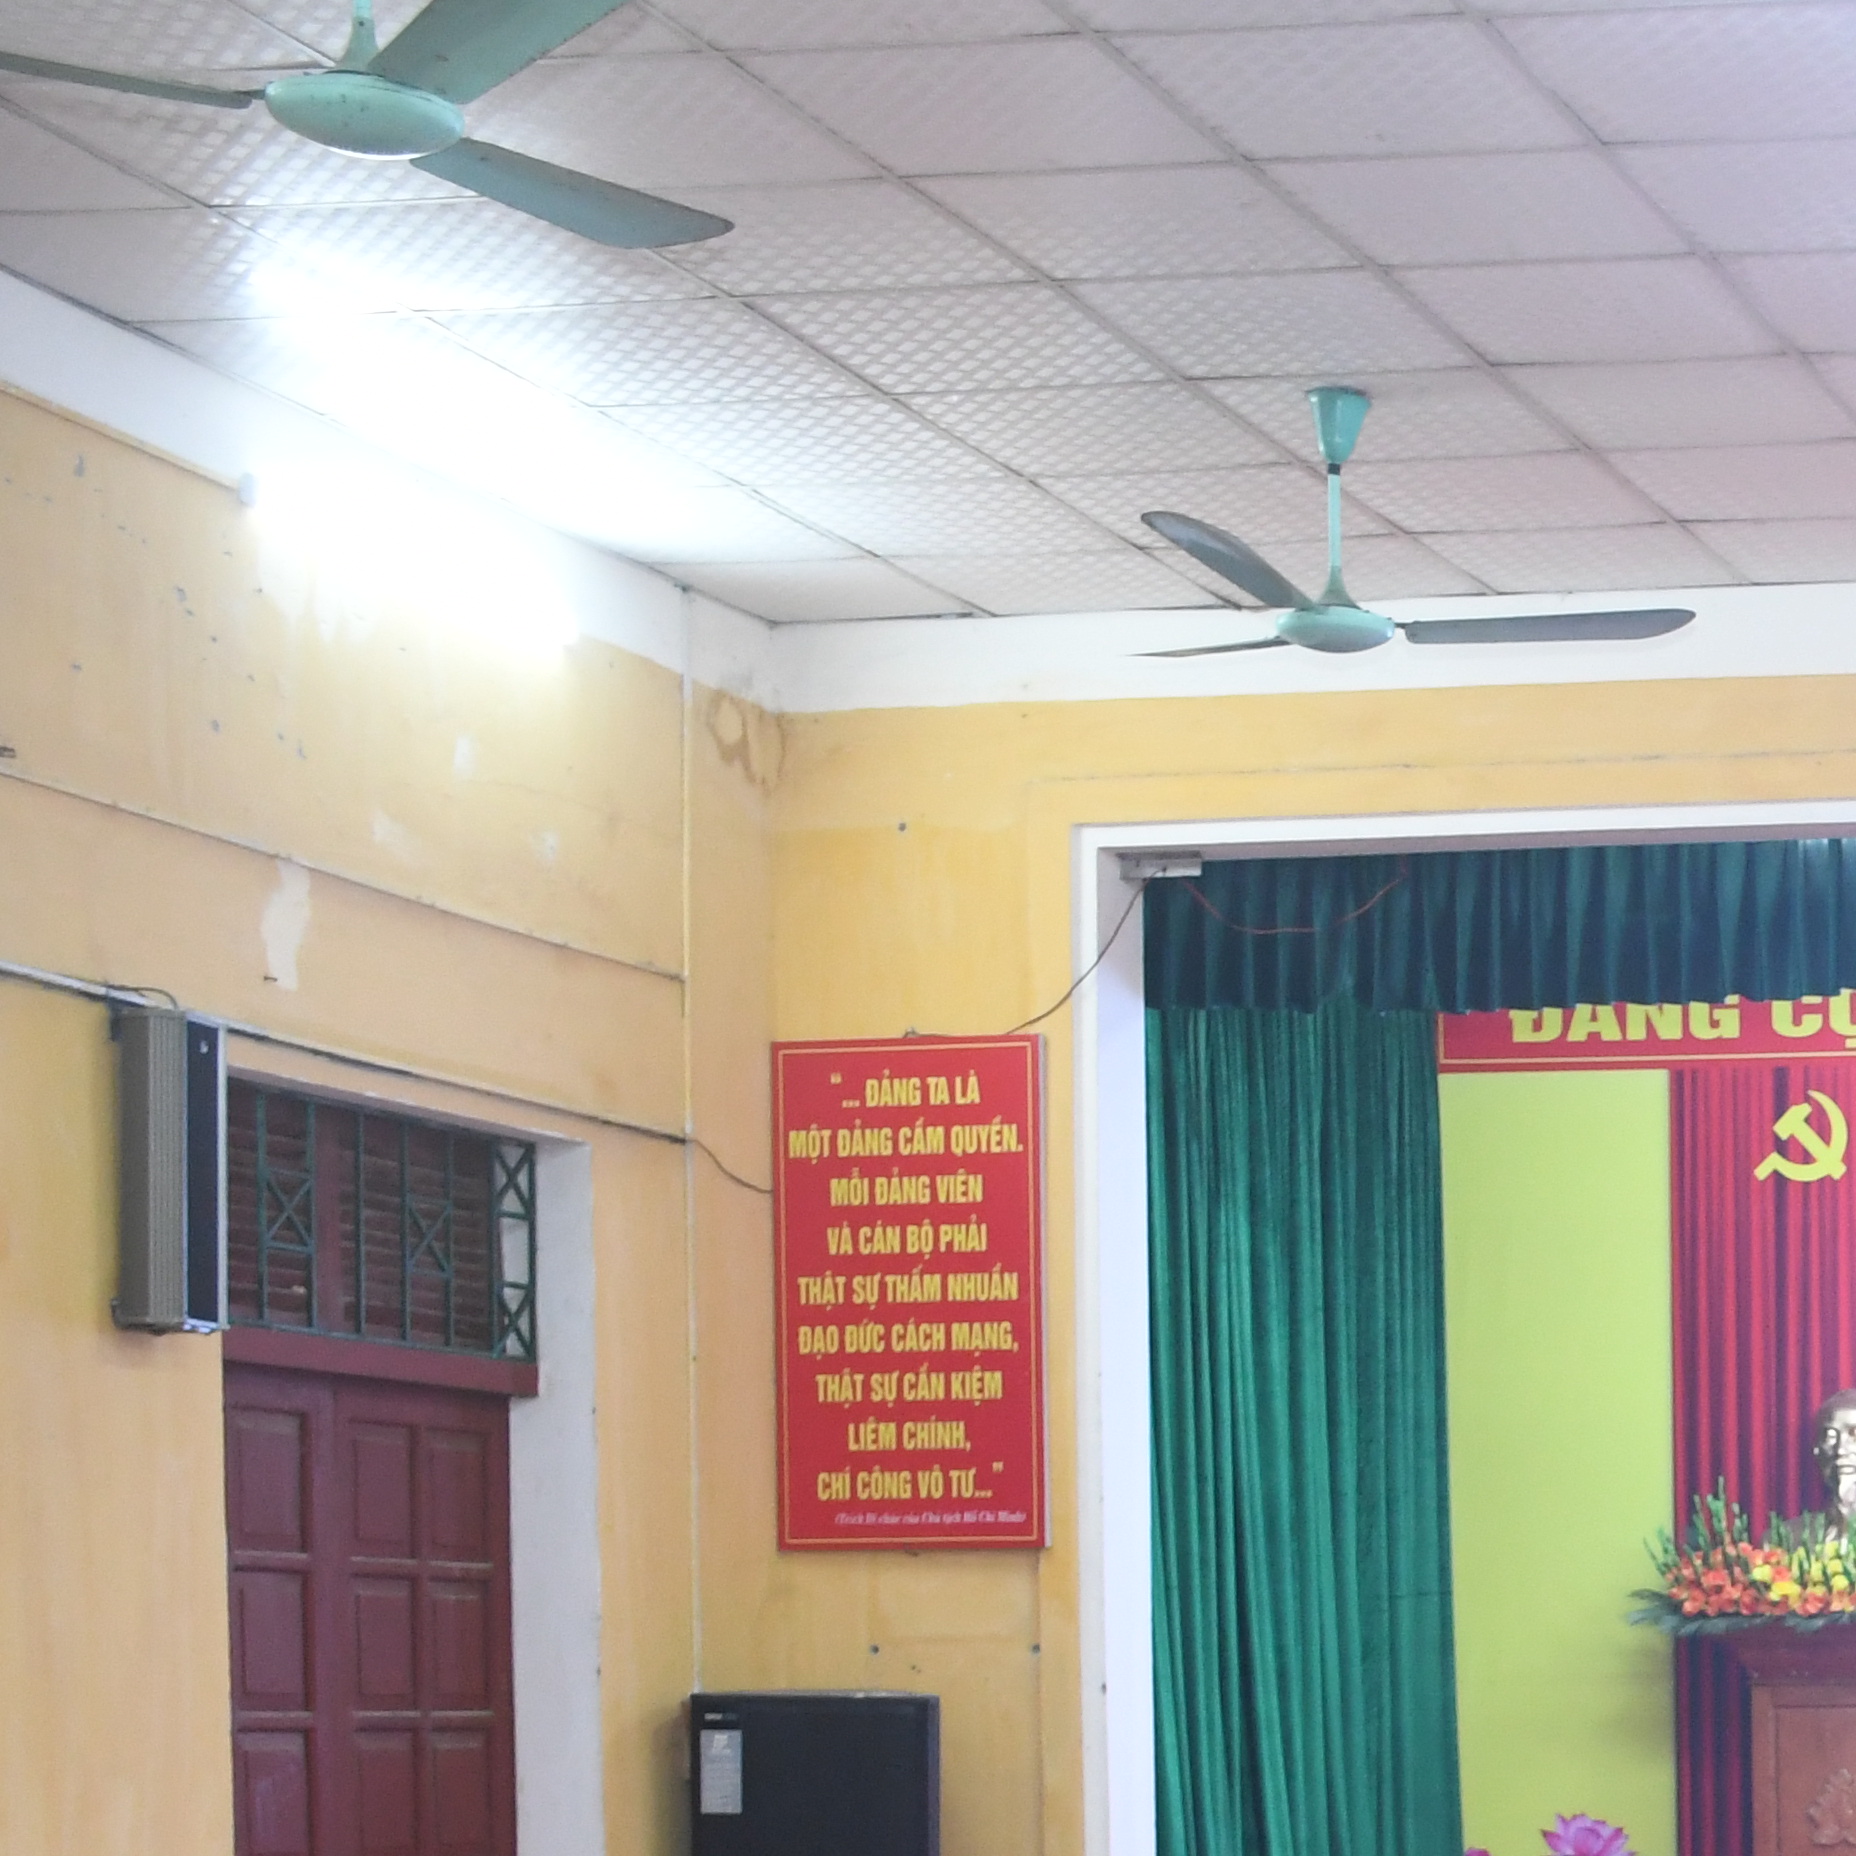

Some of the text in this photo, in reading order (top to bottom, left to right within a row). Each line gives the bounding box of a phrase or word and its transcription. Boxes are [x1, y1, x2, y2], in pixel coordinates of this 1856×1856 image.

[865, 1069, 921, 1107] ĐẢNG
[926, 1076, 950, 1105] TA
[955, 1070, 980, 1105] LÀ
[788, 1124, 832, 1164] MỘT
[837, 1119, 893, 1157] ĐẢNG
[874, 1168, 931, 1205] ĐẢNG
[936, 1170, 983, 1203] VIÊN
[827, 1214, 987, 1259] VÀ CÁN BỘ PHẢI
[798, 1271, 846, 1310] THẬT
[853, 1273, 881, 1309] SỰ
[799, 1325, 839, 1359] ĐẠO
[845, 1320, 885, 1353] ĐỨC
[892, 1319, 945, 1352] CÁCH
[816, 1370, 864, 1408] THẬT
[871, 1371, 899, 1407] SỰ
[951, 1368, 1002, 1405] KIỆM
[849, 1419, 896, 1451] LIÊM
[818, 1468, 850, 1500] CHÍ
[857, 1466, 911, 1499] CÔNG
[918, 1466, 943, 1498] VÔ
